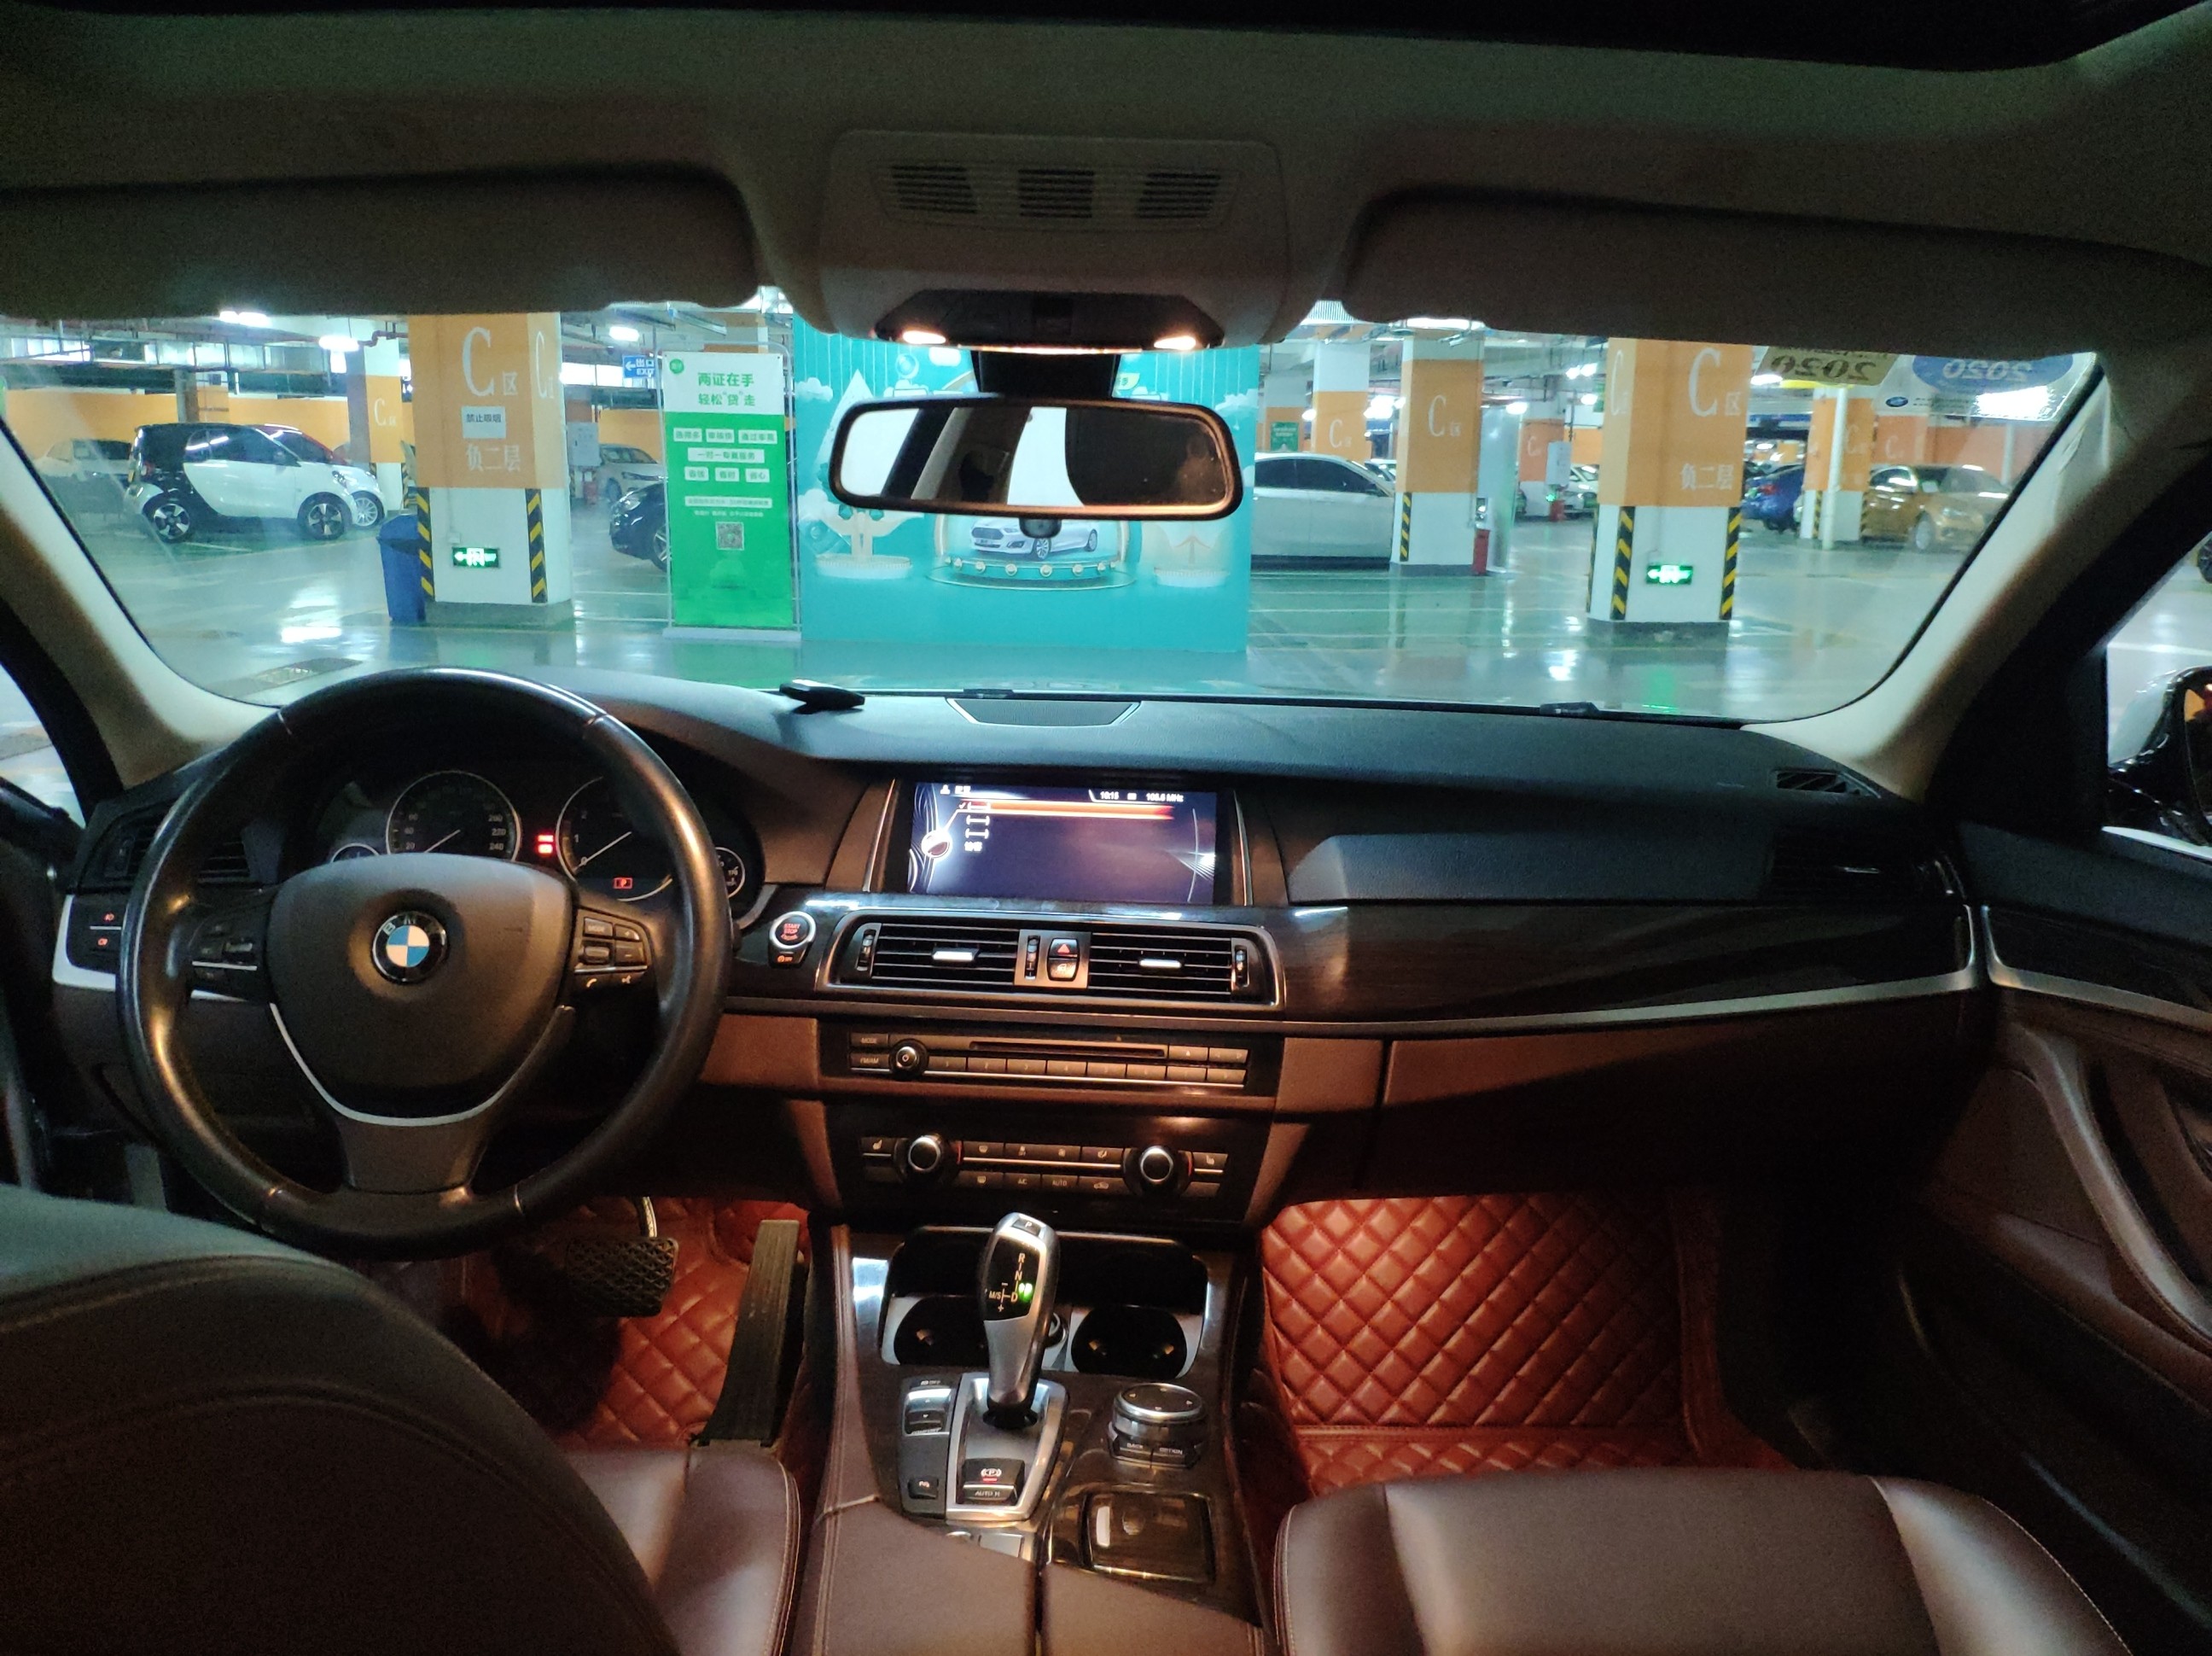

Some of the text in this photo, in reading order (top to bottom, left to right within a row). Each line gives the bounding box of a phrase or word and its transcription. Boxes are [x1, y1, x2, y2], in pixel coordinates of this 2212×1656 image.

[636, 358, 655, 367] 出口
[698, 372, 754, 388] 两证在手
[466, 413, 502, 423] 禁止吸烟
[466, 443, 521, 472] 负二层
[1018, 1252, 1026, 1263] R
[1015, 1270, 1023, 1281] N
[988, 1290, 1019, 1303] M/S D
